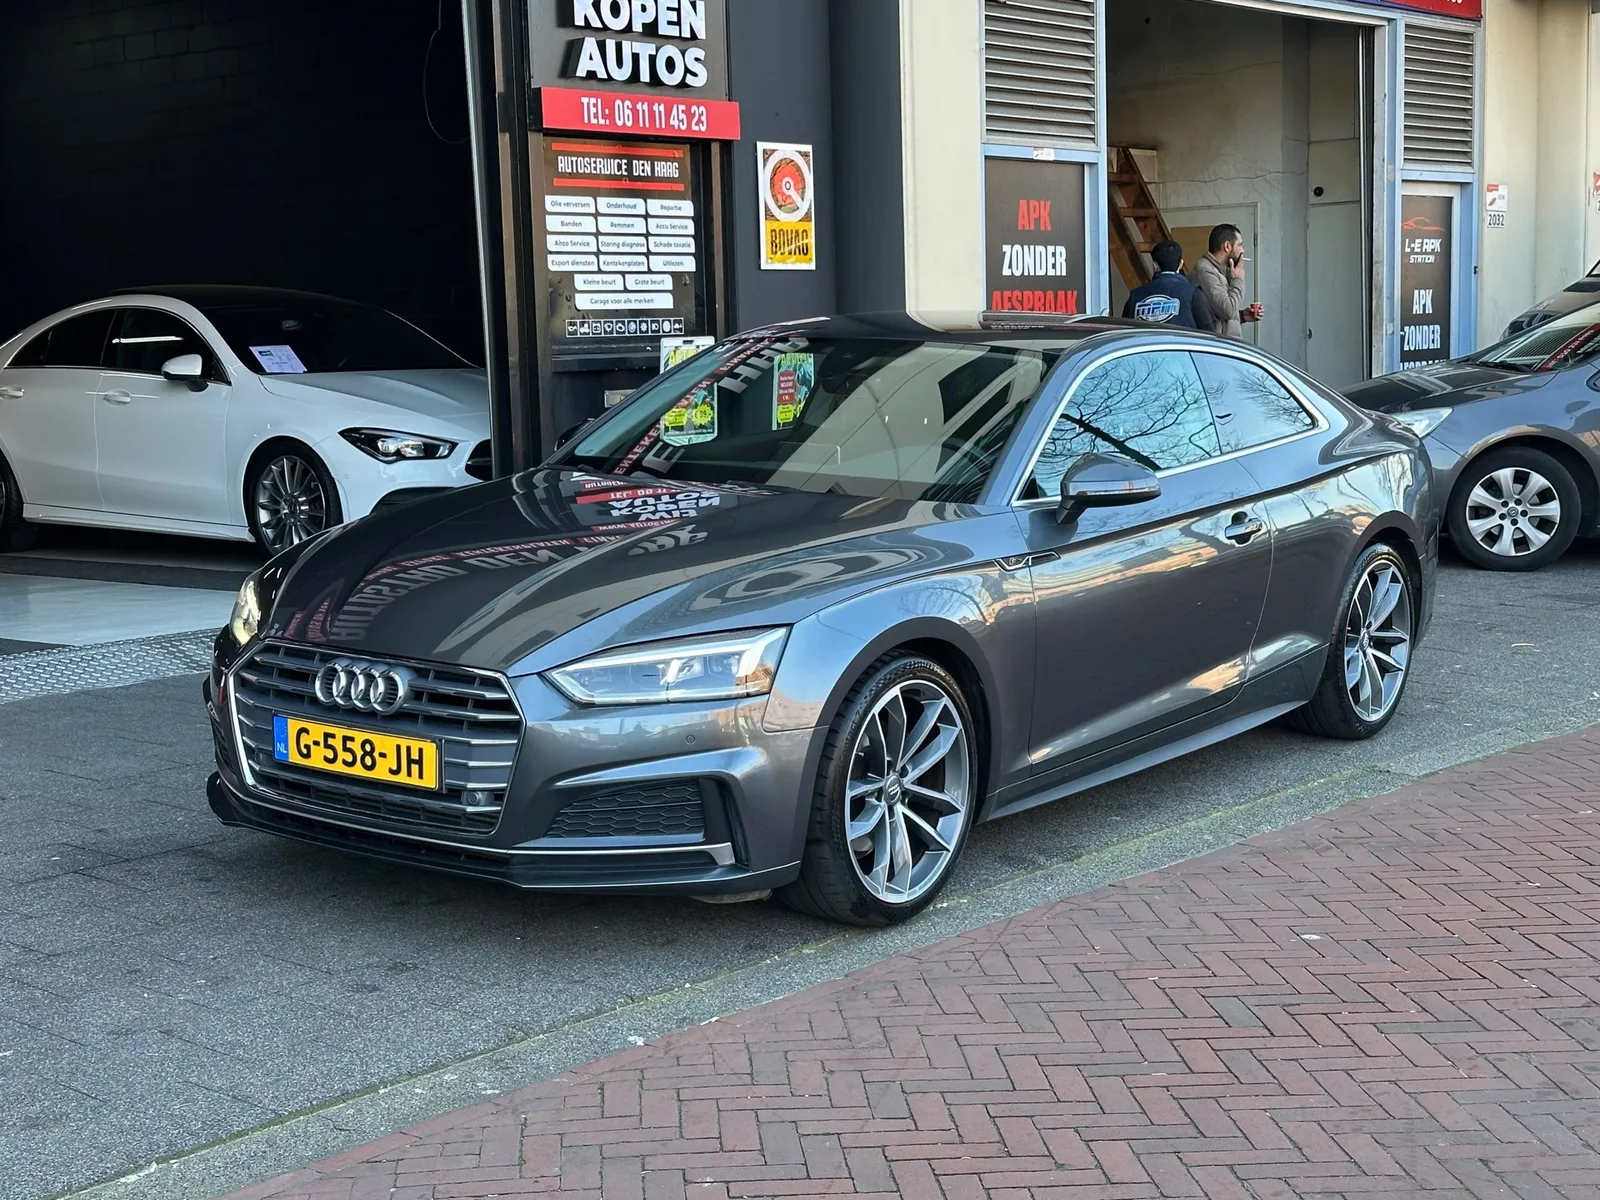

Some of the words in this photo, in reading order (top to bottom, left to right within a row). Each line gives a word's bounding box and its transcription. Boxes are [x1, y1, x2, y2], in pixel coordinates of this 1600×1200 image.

[573, 0, 706, 39] KOPEN
[575, 36, 708, 87] AUTOS
[580, 97, 609, 125] TEL:
[614, 98, 633, 127] 06
[636, 101, 649, 128] 11
[653, 102, 666, 129] 11
[669, 104, 687, 131] 45
[691, 105, 707, 132] 23
[558, 155, 628, 176] AUTOSERVICE
[632, 160, 651, 177] DEN
[654, 161, 679, 178] HAAG
[550, 200, 564, 208] Olie
[564, 201, 590, 209] verversen
[606, 201, 637, 210] Onderhoud
[1017, 199, 1051, 231] APK
[1488, 213, 1505, 226] 2032
[560, 220, 582, 228] Banden
[610, 221, 635, 229] Remmen
[669, 223, 688, 231] Service
[554, 239, 569, 247] Airco
[570, 240, 590, 248] Service
[600, 240, 620, 249] Storing
[621, 241, 645, 249] diagnose
[653, 240, 673, 248] Schade
[770, 228, 809, 256] BOVAG
[1404, 238, 1422, 253] L-E
[1424, 238, 1442, 253] APK
[551, 259, 570, 268] Export
[571, 259, 594, 267] diensten
[602, 260, 645, 268] Kentekenplaten
[662, 259, 684, 267] Uitlezen
[1001, 244, 1067, 276] ZONDER
[1409, 254, 1435, 264] STATION
[583, 278, 599, 286] Kleine
[600, 278, 616, 286] beurt
[634, 278, 649, 286] Grote
[650, 278, 665, 286] beurt
[589, 297, 609, 306] Garage
[991, 290, 1078, 315] AFSPRAAK
[1412, 289, 1433, 315] APK
[1403, 324, 1441, 351] ZONDER
[276, 742, 288, 754] NL
[294, 726, 424, 780] G-558-JH
